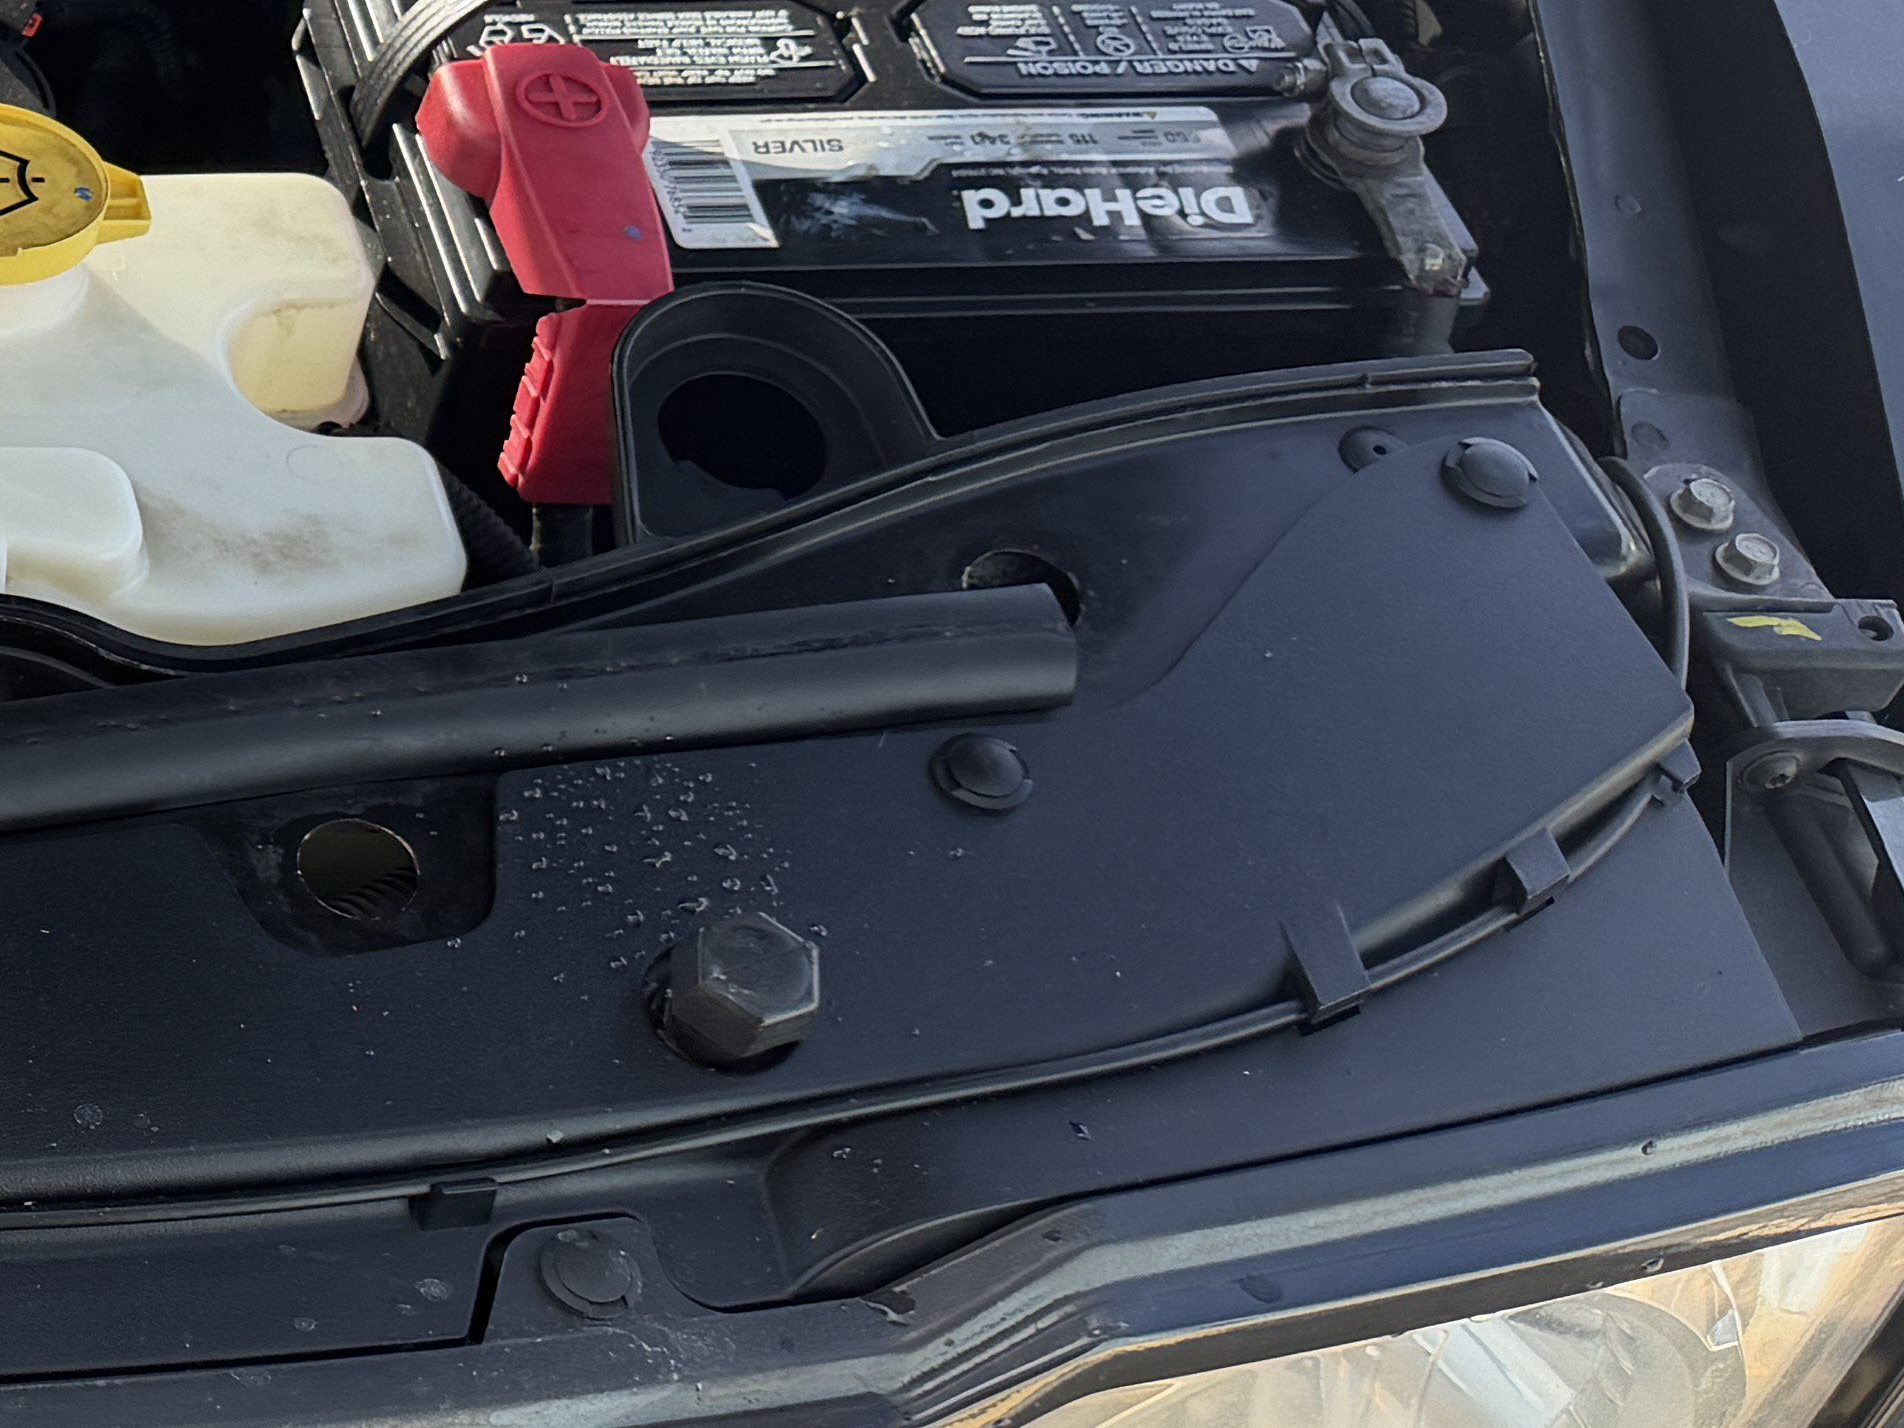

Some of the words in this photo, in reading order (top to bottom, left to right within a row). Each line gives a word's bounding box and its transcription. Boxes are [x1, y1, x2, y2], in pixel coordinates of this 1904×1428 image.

[1017, 60, 1116, 76] POISON
[1136, 58, 1235, 74] DANGER
[752, 138, 844, 156] SILVER
[960, 186, 1255, 231] DieHard
